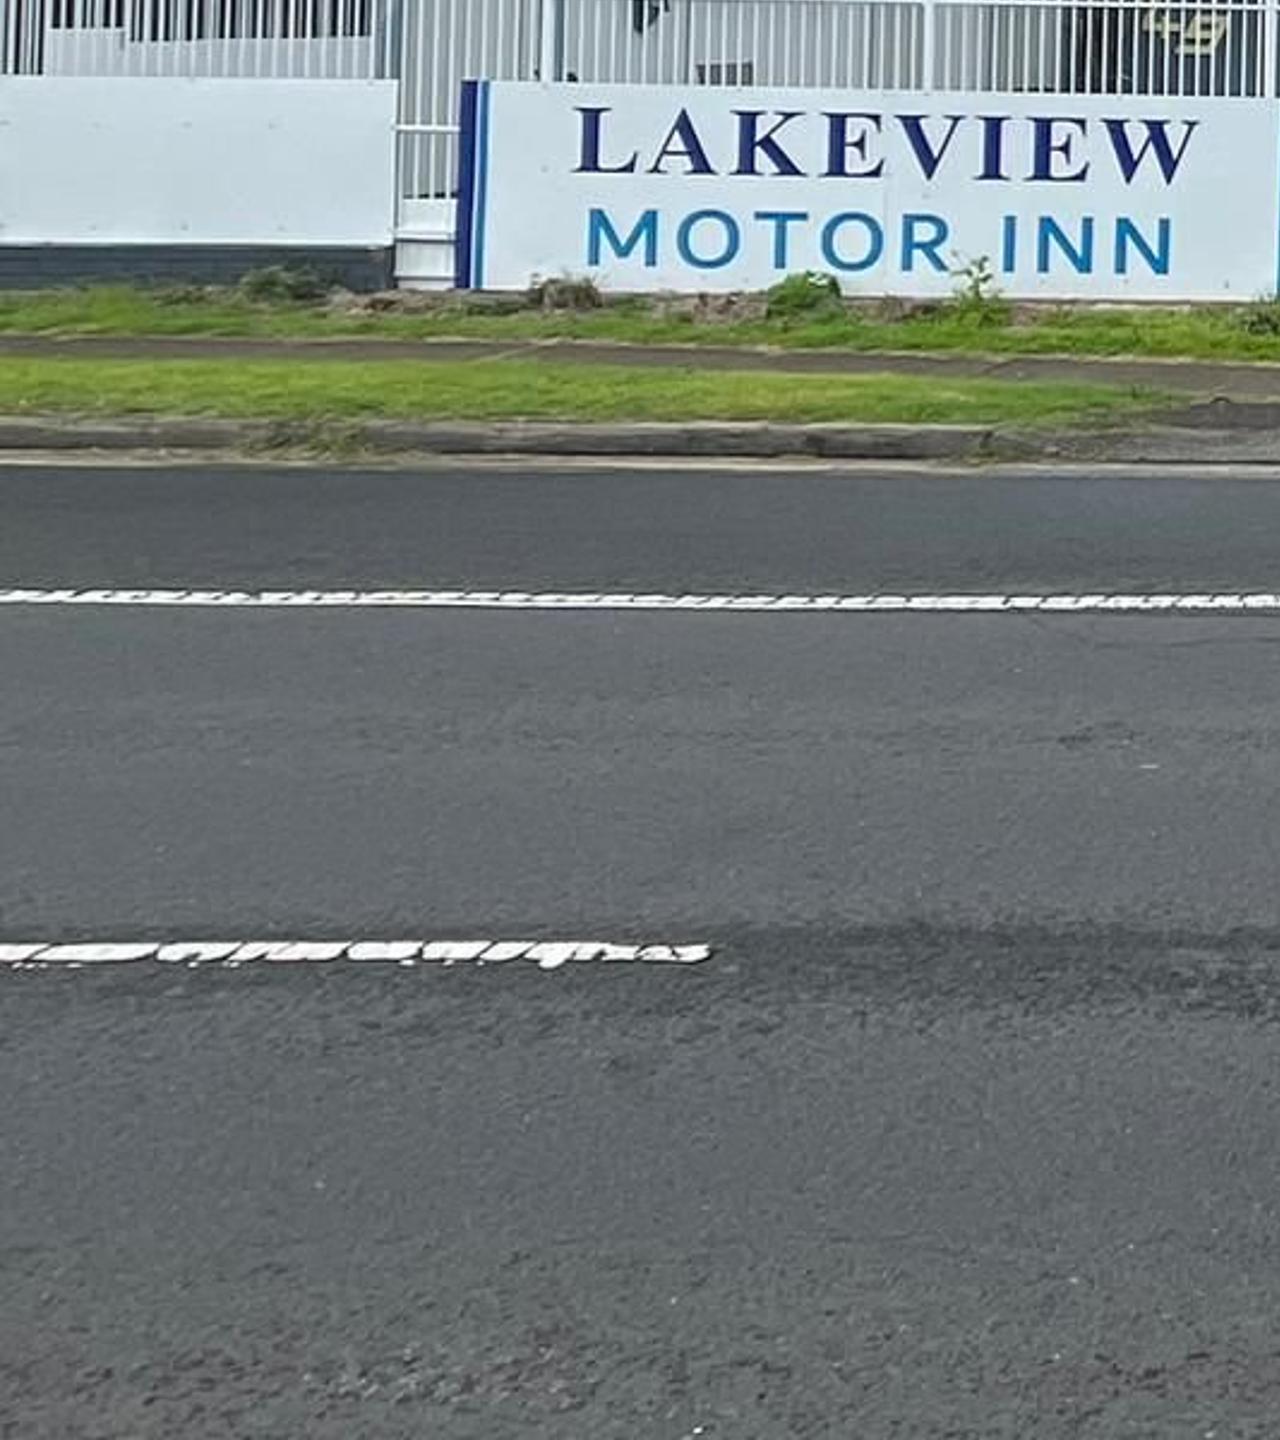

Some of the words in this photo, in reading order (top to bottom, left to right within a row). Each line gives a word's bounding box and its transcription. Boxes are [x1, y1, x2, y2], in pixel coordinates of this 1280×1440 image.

[570, 106, 1202, 187] LAKEVIEW
[586, 208, 950, 273] MOTOR
[1002, 213, 1172, 276] INN
